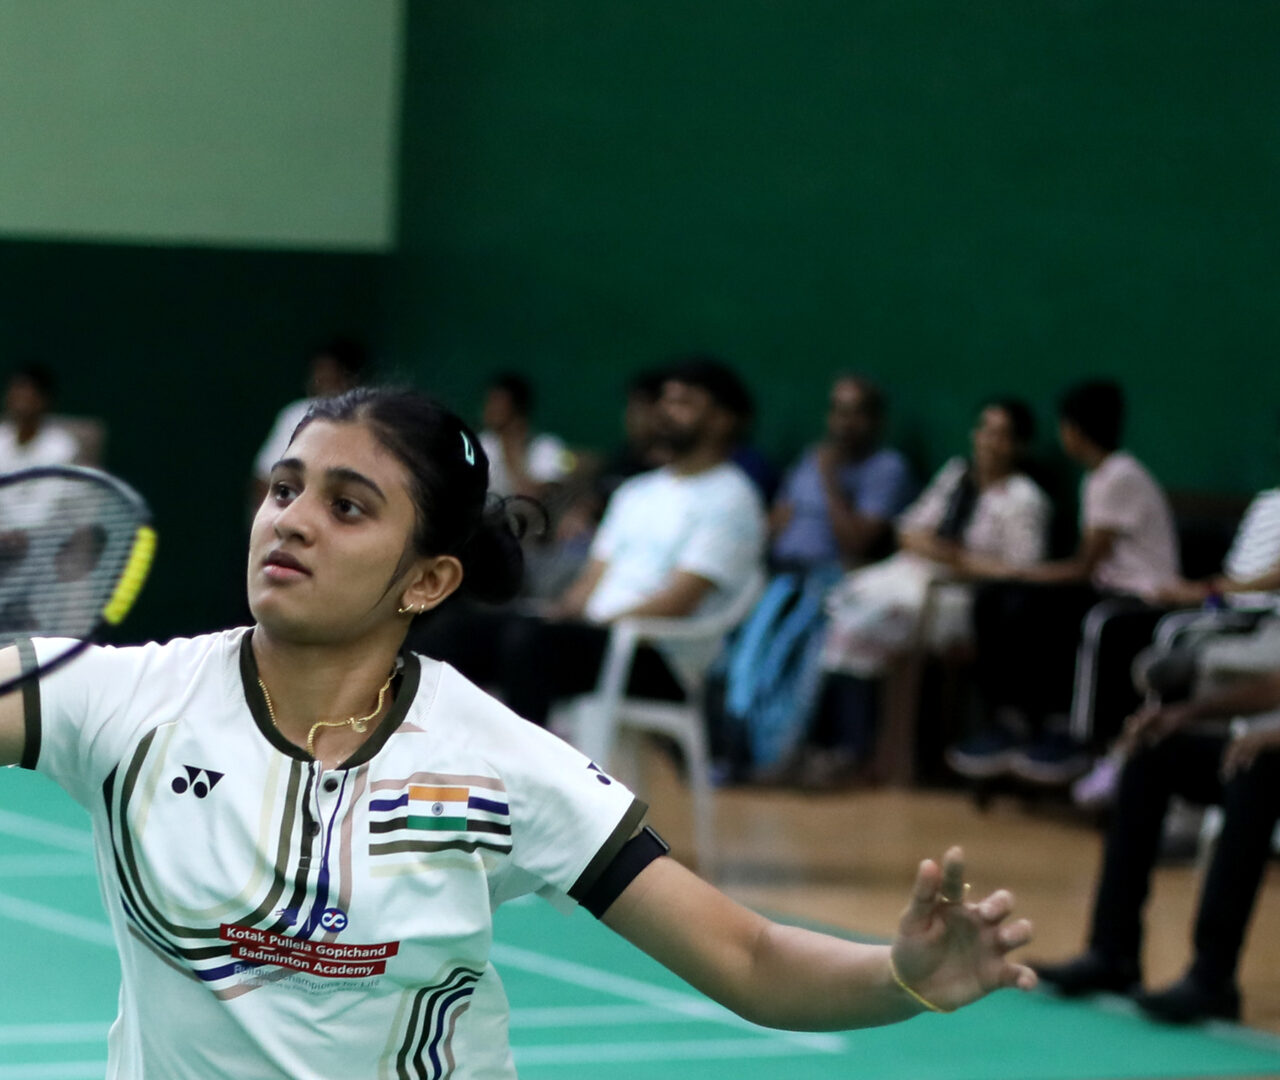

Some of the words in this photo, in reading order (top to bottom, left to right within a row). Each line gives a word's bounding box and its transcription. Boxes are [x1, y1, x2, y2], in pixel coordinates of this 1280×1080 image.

[226, 928, 265, 943] Kotak
[269, 935, 312, 952] Pullela
[315, 944, 387, 958] Gopichand
[239, 947, 310, 969] Badminton
[313, 962, 375, 976] Academy
